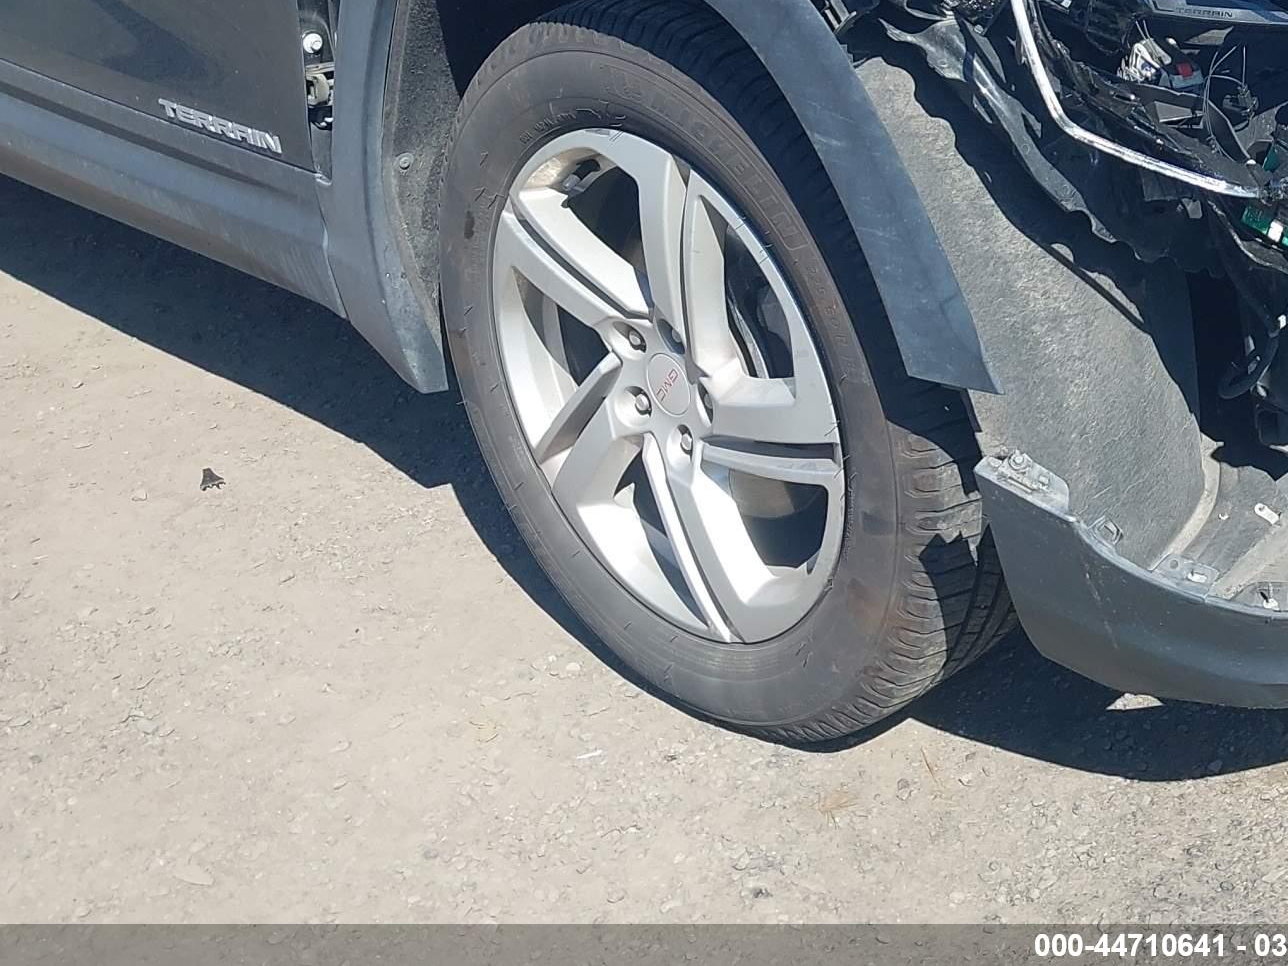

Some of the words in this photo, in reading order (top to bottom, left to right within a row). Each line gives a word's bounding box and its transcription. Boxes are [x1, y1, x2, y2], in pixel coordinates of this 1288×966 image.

[1176, 7, 1233, 18] TERRAIN
[158, 98, 282, 153] TERRAIN
[657, 368, 679, 402] GMC
